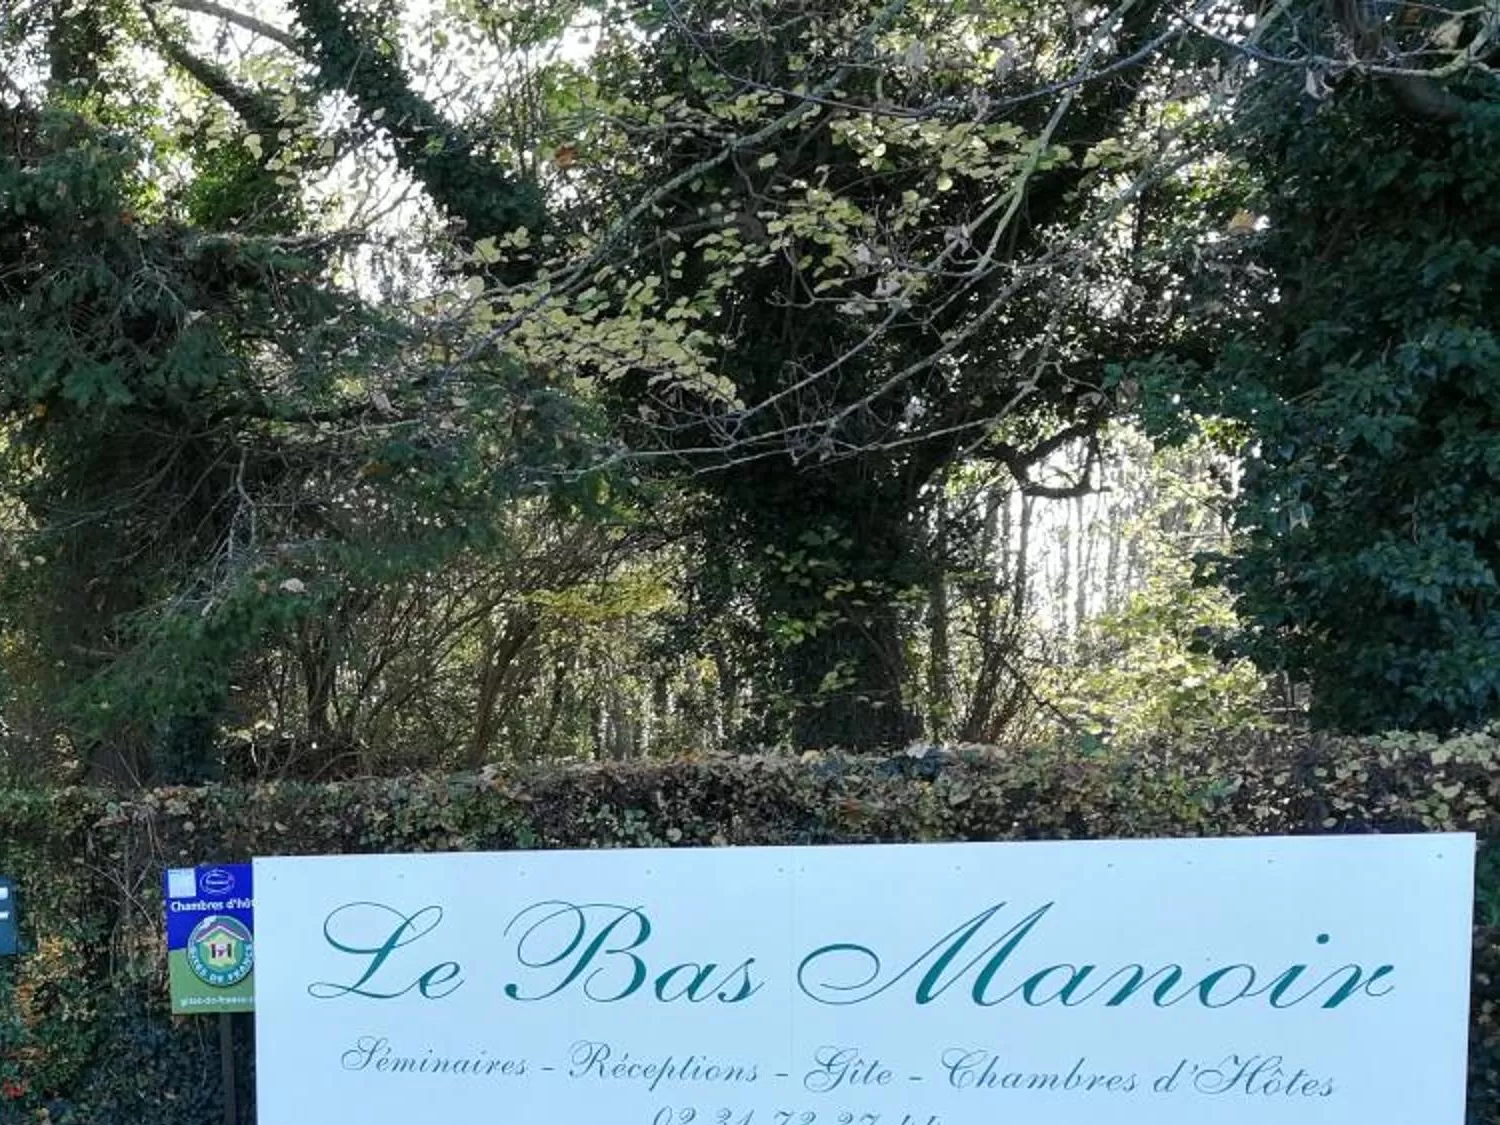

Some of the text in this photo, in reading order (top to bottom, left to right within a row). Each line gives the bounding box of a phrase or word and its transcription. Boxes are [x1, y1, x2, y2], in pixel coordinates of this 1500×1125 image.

[171, 899, 224, 912] Chambres
[307, 899, 1395, 1010] Le Bas Manoir
[340, 1035, 527, 1076] Séminaires
[568, 1039, 759, 1093] Réceptions
[803, 1045, 893, 1093] Gîte
[941, 1047, 1137, 1093] Chambres
[1153, 1053, 1335, 1098] d'Hôtes
